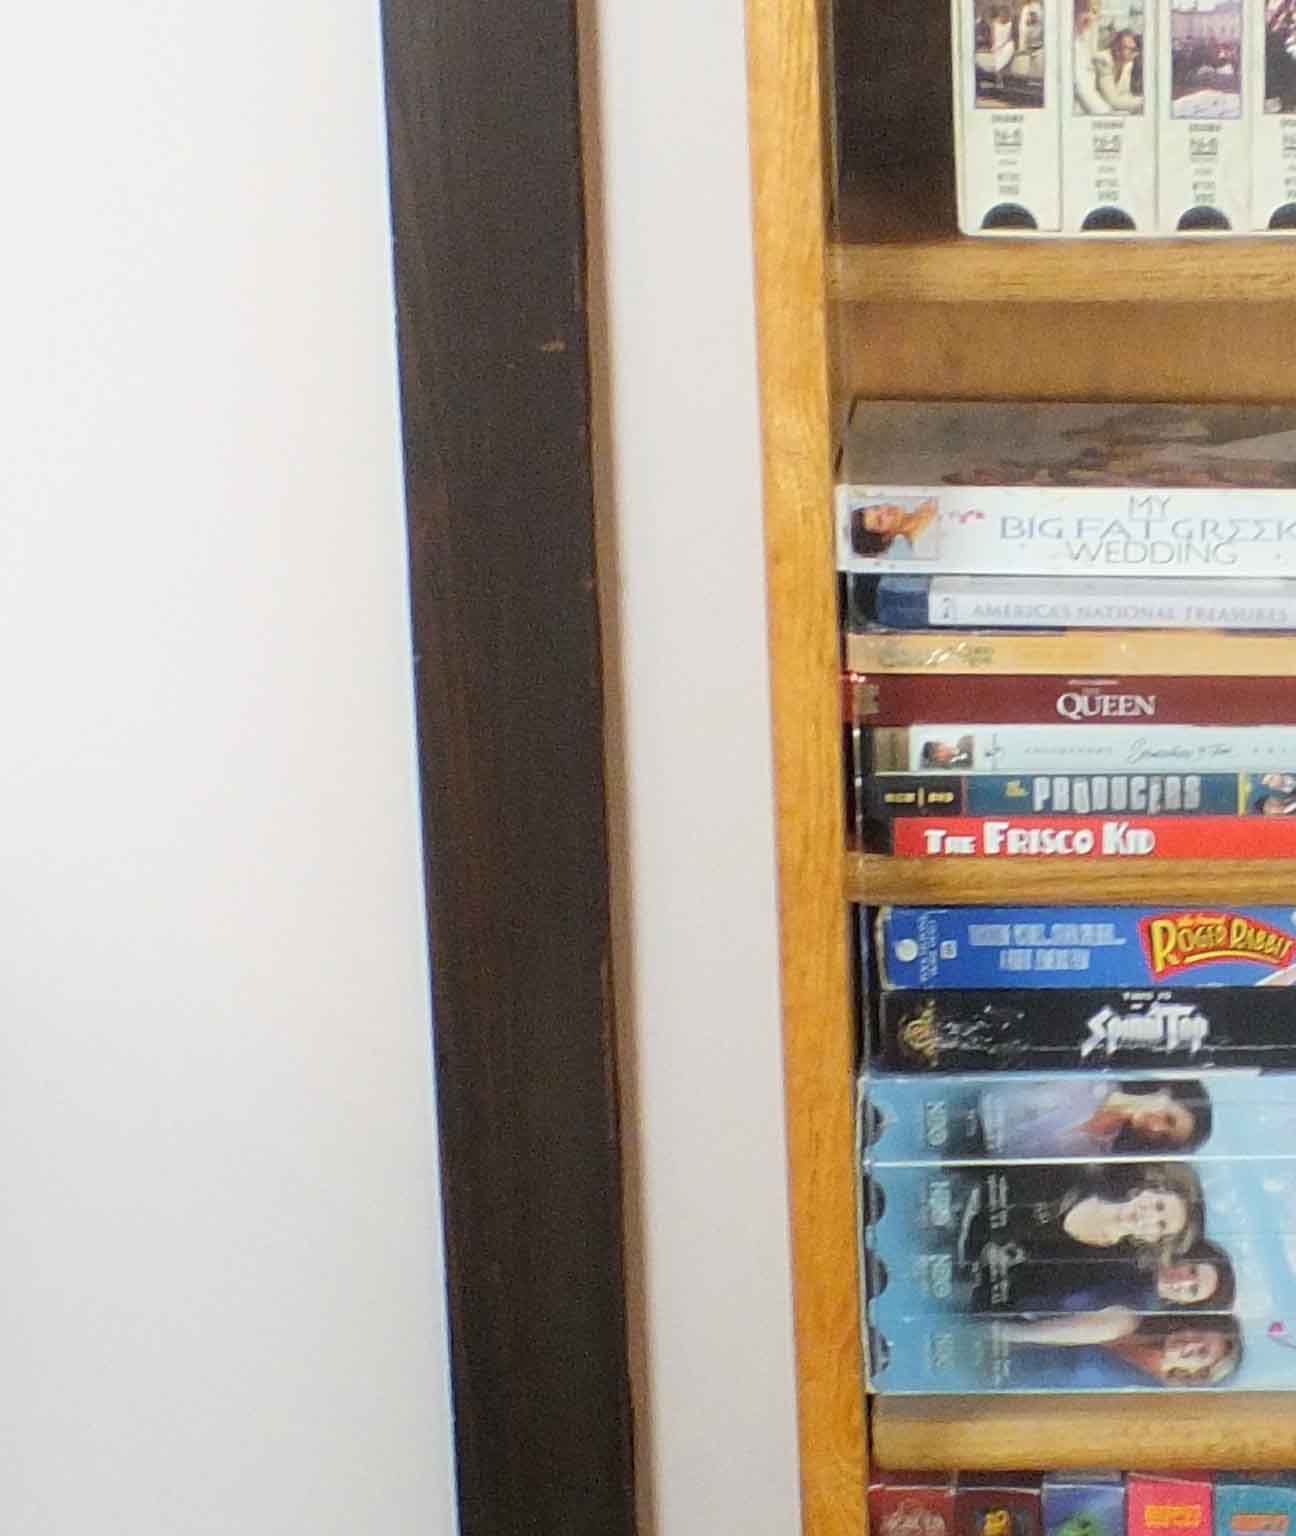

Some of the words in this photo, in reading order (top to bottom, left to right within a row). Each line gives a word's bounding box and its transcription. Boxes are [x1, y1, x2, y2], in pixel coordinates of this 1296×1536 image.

[1128, 495, 1173, 518] MY
[1000, 516, 1064, 540] BIG
[1075, 517, 1154, 541] FAT
[1066, 541, 1238, 565] WEDDING
[1056, 693, 1157, 720] QUEEN
[1033, 775, 1201, 814] PRODUCERS
[982, 821, 1094, 856] FRISCO
[1102, 821, 1157, 856] KID
[1230, 917, 1295, 960] RABBIT
